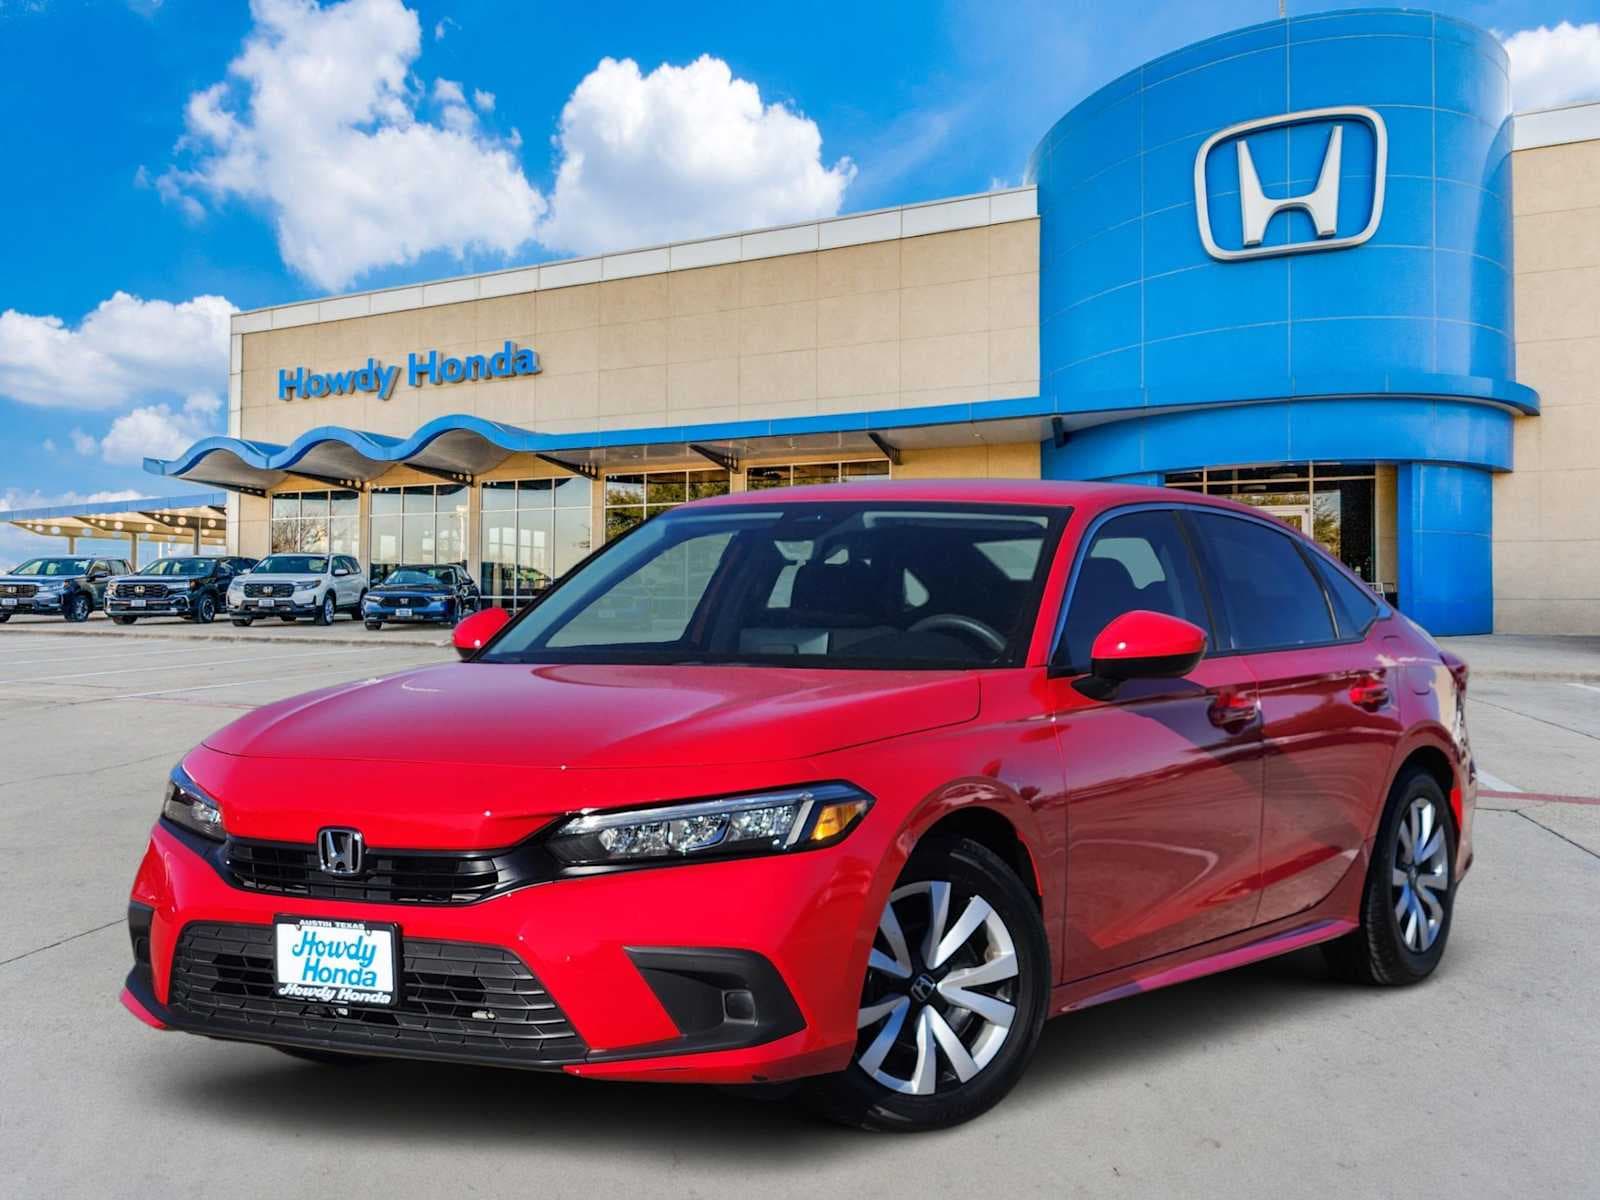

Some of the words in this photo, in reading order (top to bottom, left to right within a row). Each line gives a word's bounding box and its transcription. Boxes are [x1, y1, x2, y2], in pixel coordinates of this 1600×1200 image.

[278, 358, 401, 400] Howdy
[408, 341, 541, 386] Honda
[299, 919, 332, 928] AUSTIN
[334, 921, 365, 930] TEXAS
[292, 930, 377, 968] Howdy
[302, 957, 378, 987] Honda
[278, 983, 337, 1001] Howdy
[337, 988, 391, 1004] Honda
